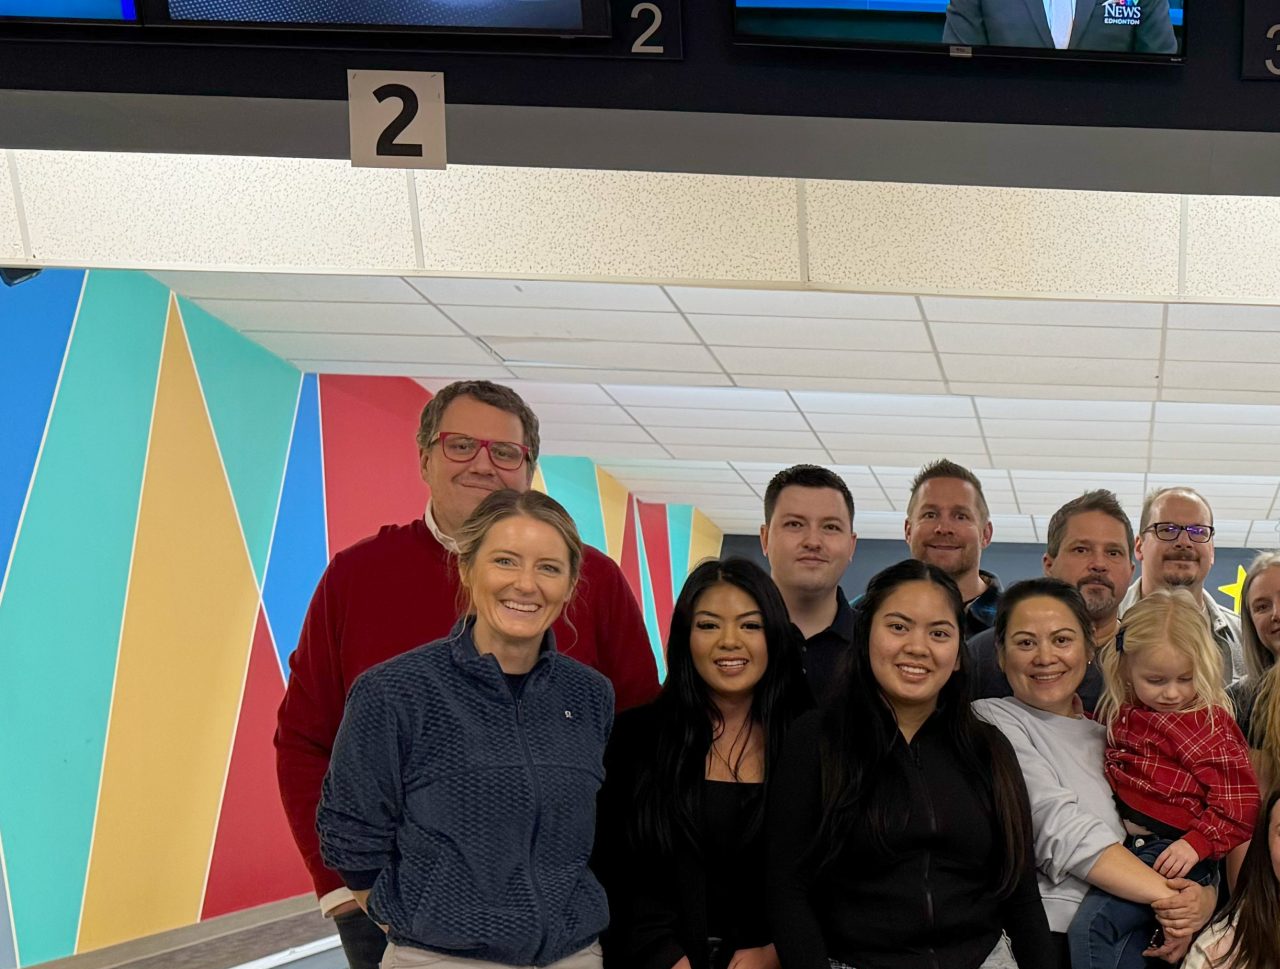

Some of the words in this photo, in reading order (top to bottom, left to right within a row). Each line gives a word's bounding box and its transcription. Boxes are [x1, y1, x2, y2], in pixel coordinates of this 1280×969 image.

[632, 3, 664, 53] 2
[1103, 4, 1141, 18] NEWS
[372, 83, 423, 158] 2
